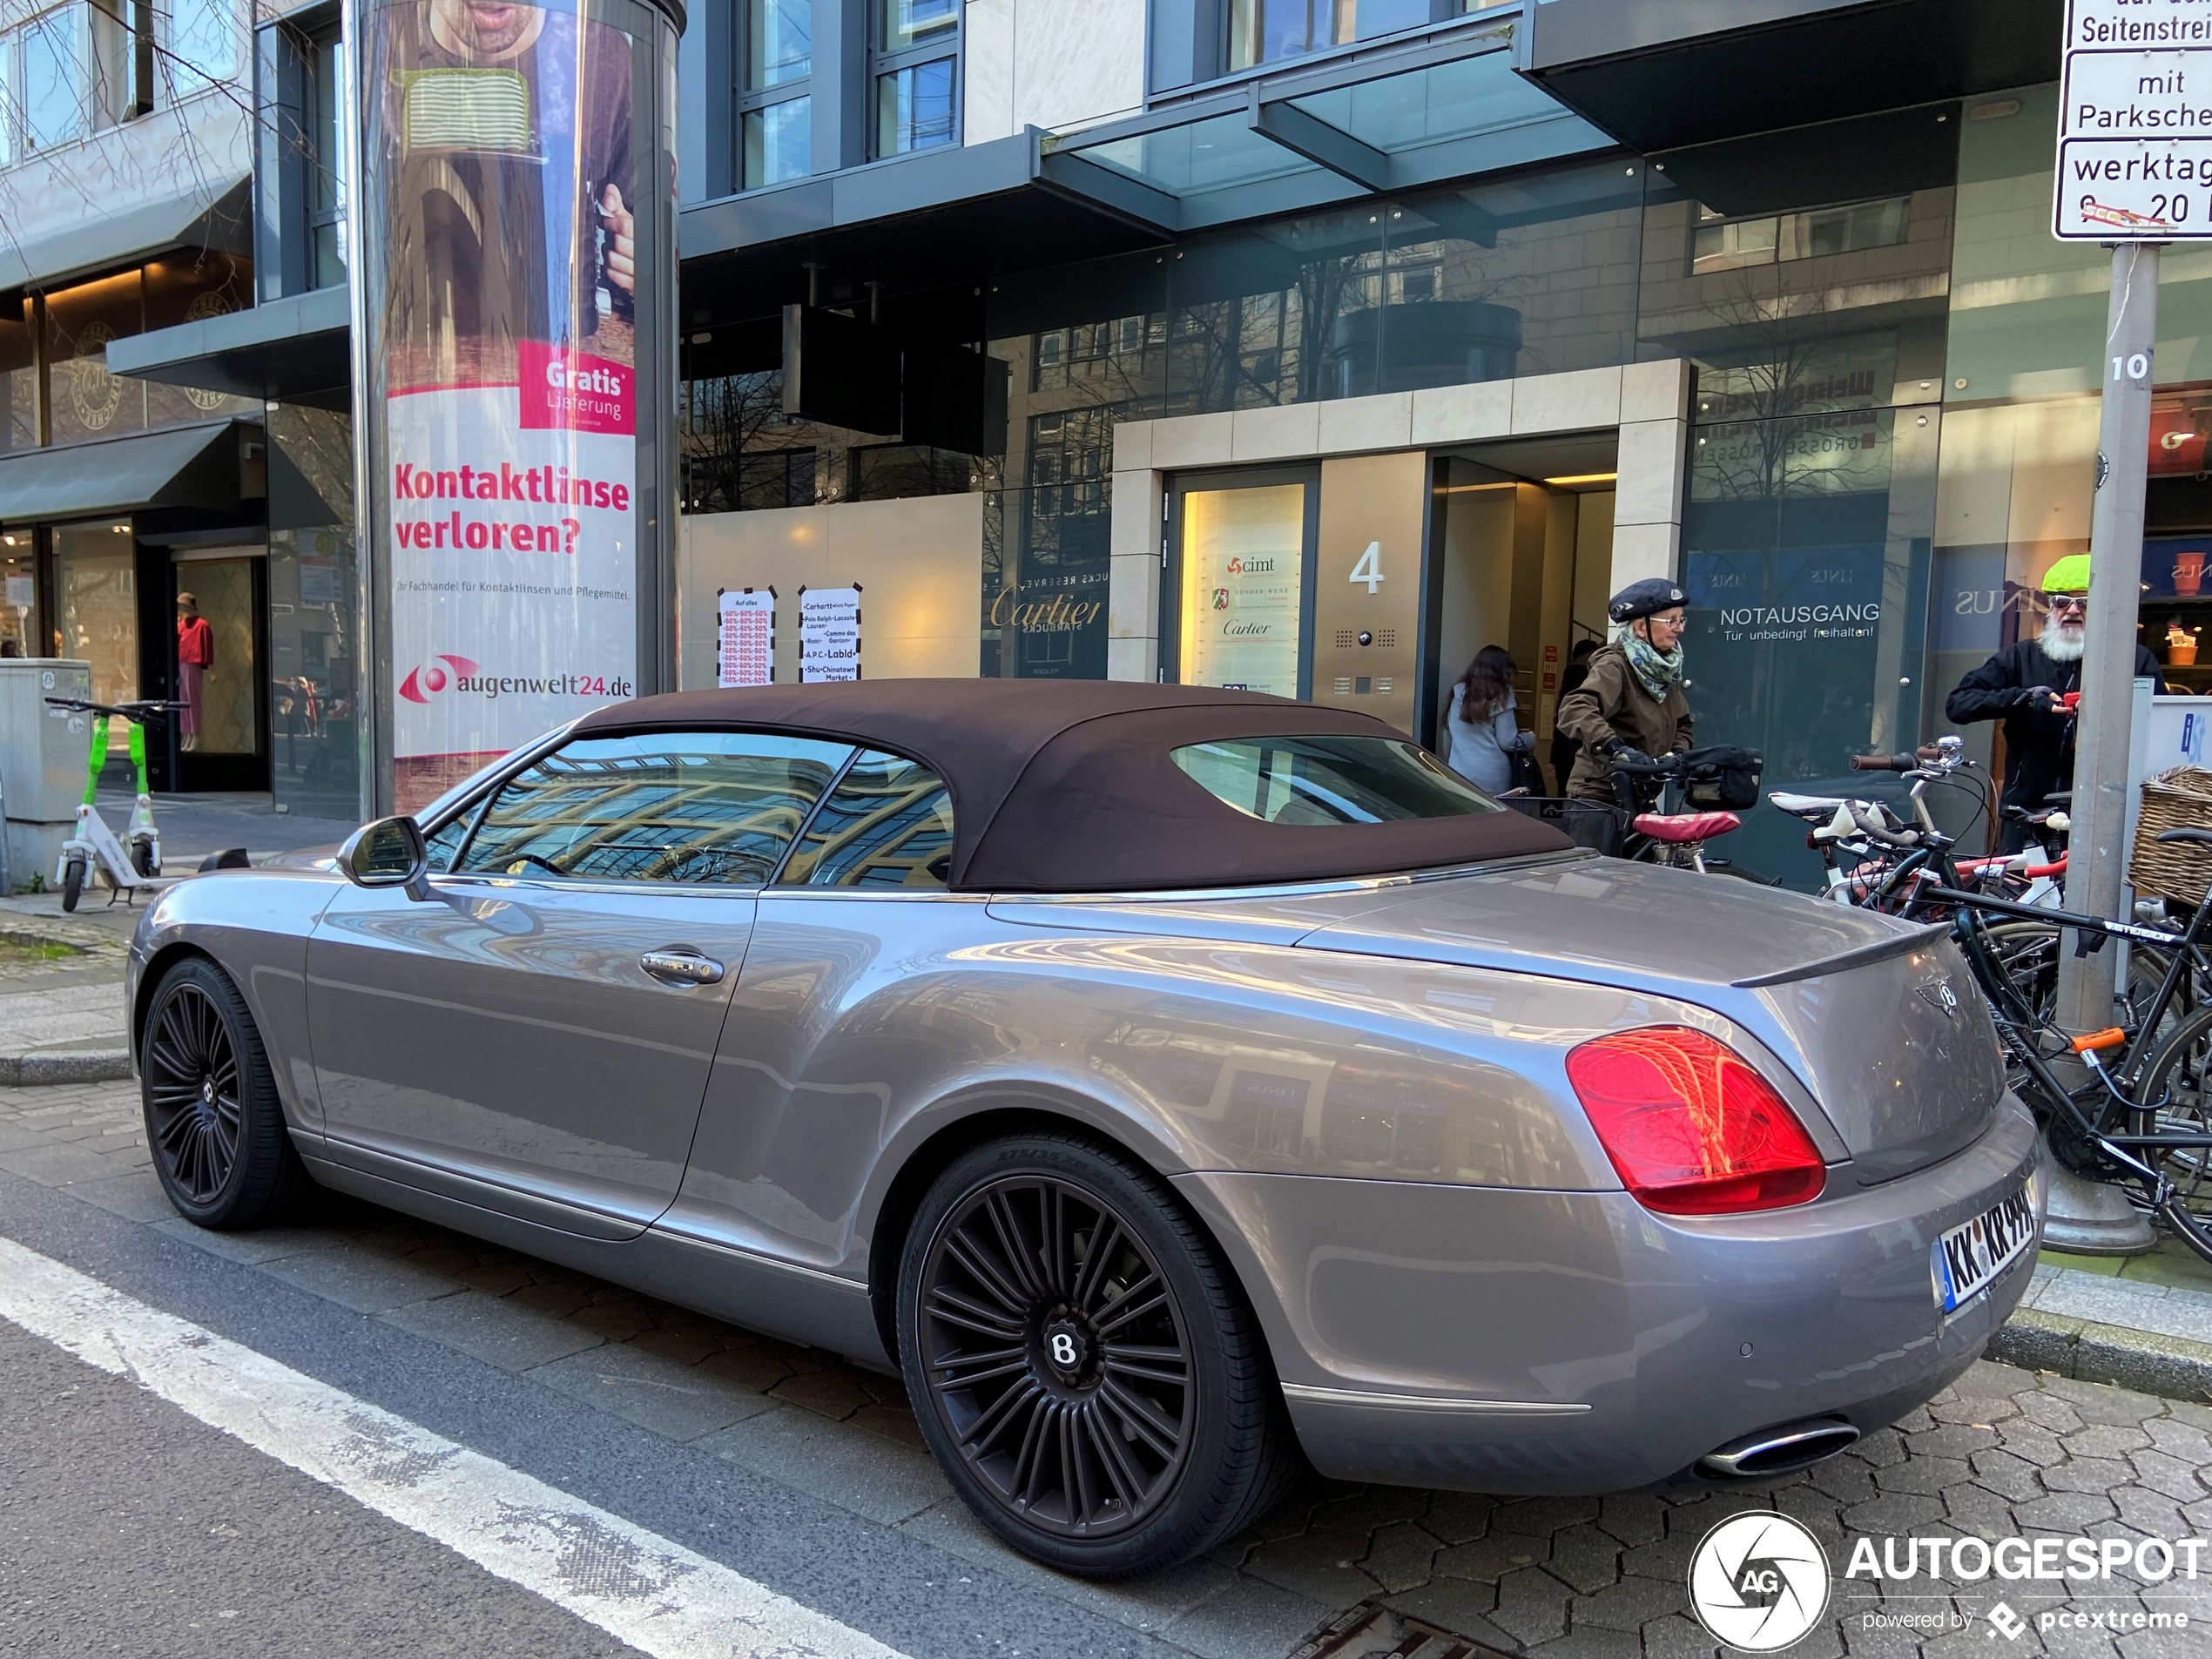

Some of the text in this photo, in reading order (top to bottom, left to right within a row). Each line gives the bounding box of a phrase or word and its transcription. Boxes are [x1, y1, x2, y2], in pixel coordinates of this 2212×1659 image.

[2139, 70, 2184, 94] mit
[2112, 354, 2148, 381] 10
[547, 390, 621, 421] Lieferung
[395, 462, 629, 511] Kontaktlinse
[395, 511, 580, 554] verloren?
[1243, 557, 1274, 572] cimt
[1349, 541, 1384, 594] 4
[409, 581, 458, 591] Fachhandel
[462, 582, 476, 591] für
[480, 582, 550, 595] Kontaktlinsen
[554, 585, 573, 596] und
[577, 587, 630, 600] Pflegemittel.
[991, 583, 1105, 627] Cartier
[1720, 603, 1879, 626] NOTAUSGANG
[1224, 619, 1271, 636] Cartier
[1724, 626, 1873, 642] Tür unbedingt freihalten!
[458, 674, 631, 698] augenwelt24.de
[1946, 1226, 1982, 1293] KK
[1052, 1334, 1076, 1364] B
